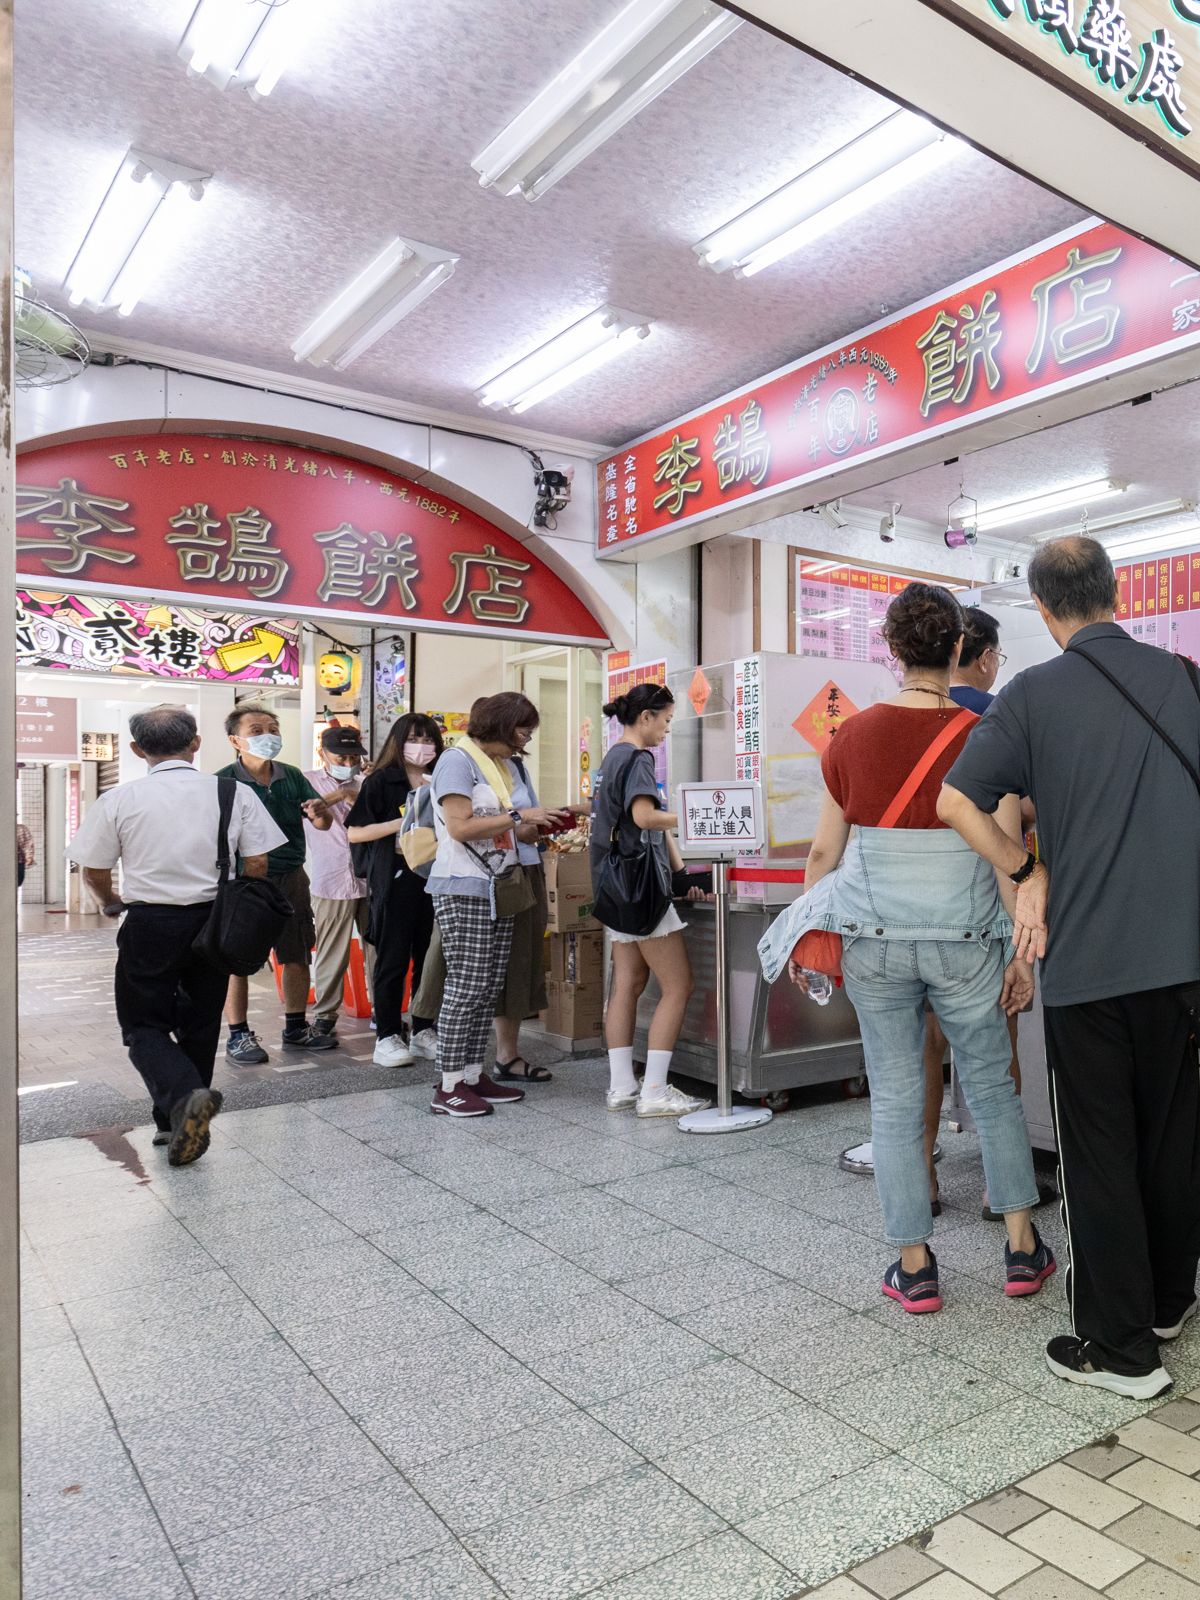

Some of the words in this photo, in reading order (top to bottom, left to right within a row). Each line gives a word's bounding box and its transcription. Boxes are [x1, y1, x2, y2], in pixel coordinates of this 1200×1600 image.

[688, 806, 753, 820] 非工作人員
[693, 821, 751, 836] 禁止進入
